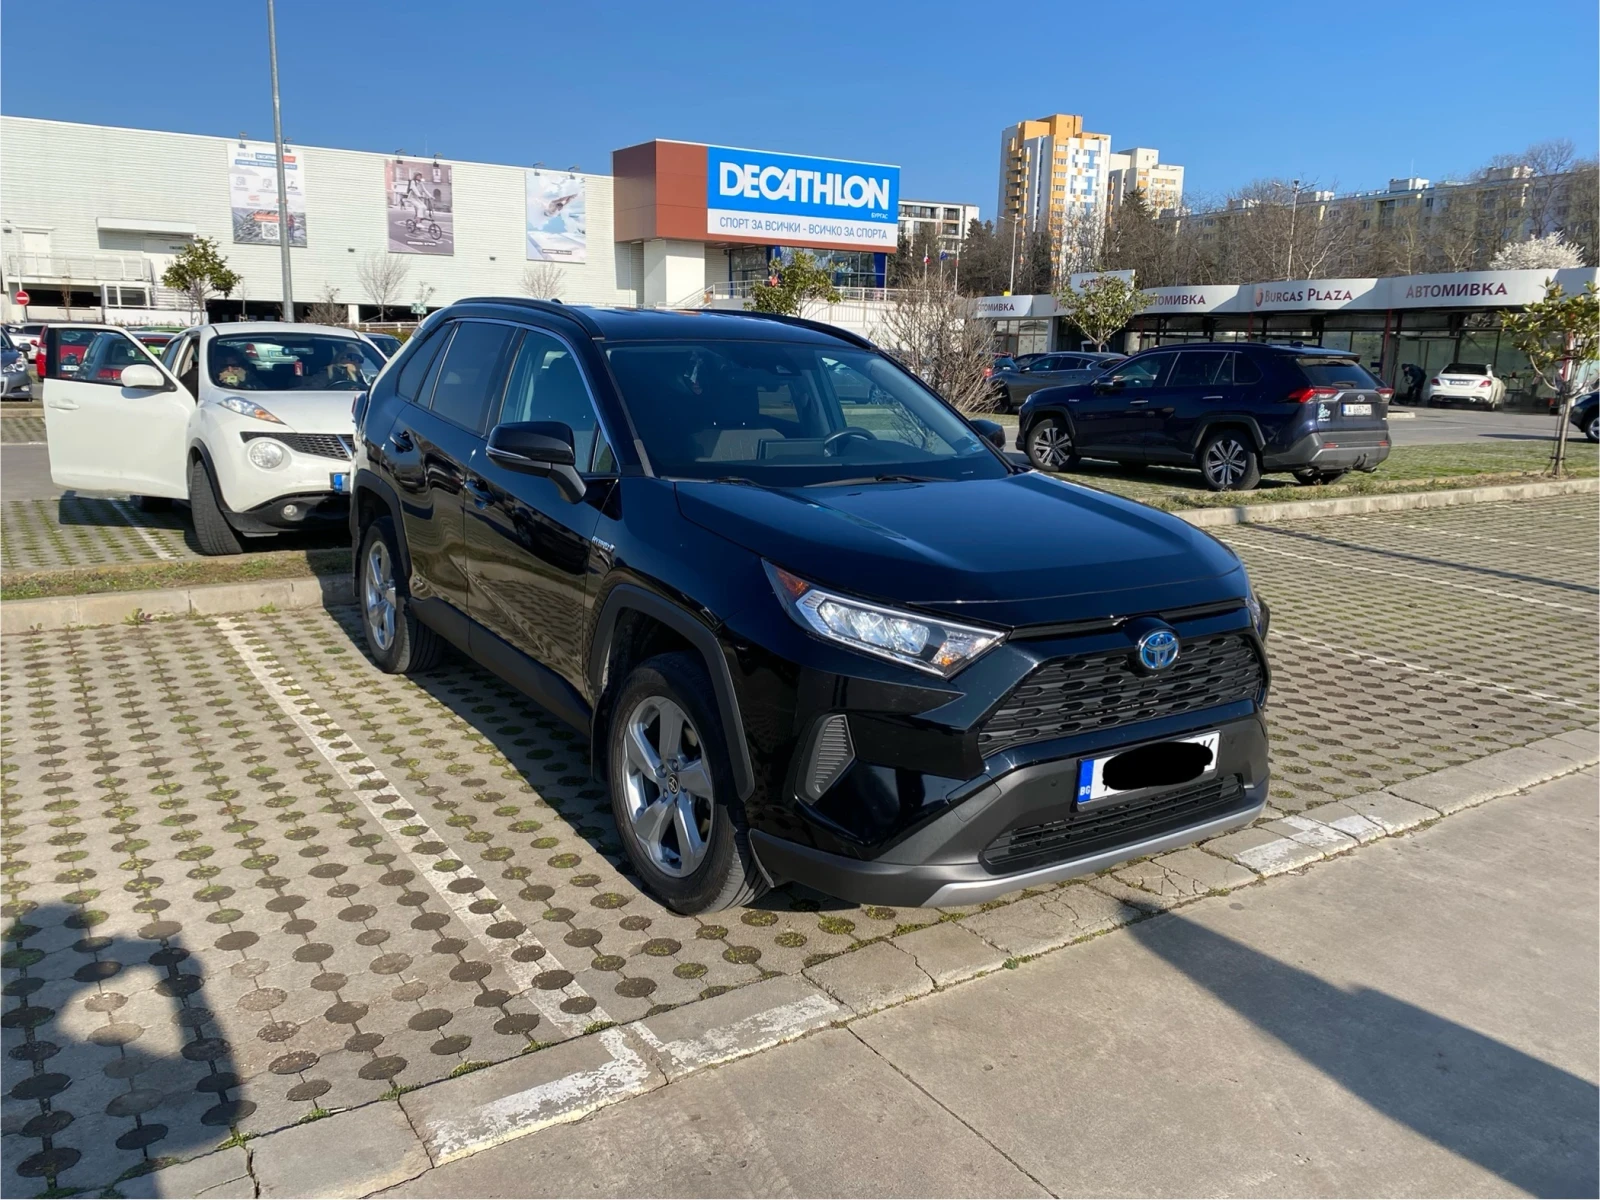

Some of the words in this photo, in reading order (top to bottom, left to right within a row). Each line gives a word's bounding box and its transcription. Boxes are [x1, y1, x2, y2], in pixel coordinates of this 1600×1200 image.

[719, 162, 889, 210] DECATHLON
[719, 216, 749, 229] СПОРТ
[751, 220, 763, 230] ЗА
[765, 221, 800, 233] ВСИЧКИ
[808, 225, 842, 236] ВСИЧКО
[843, 226, 855, 237] ЗА
[856, 228, 888, 239] СПОРТА
[1264, 289, 1304, 303] BURGAS
[1307, 287, 1353, 301] PLAZA
[1405, 282, 1508, 299] АВТОМИВКА
[1148, 294, 1207, 306] ТОМИВКА
[1080, 786, 1091, 796] BG
